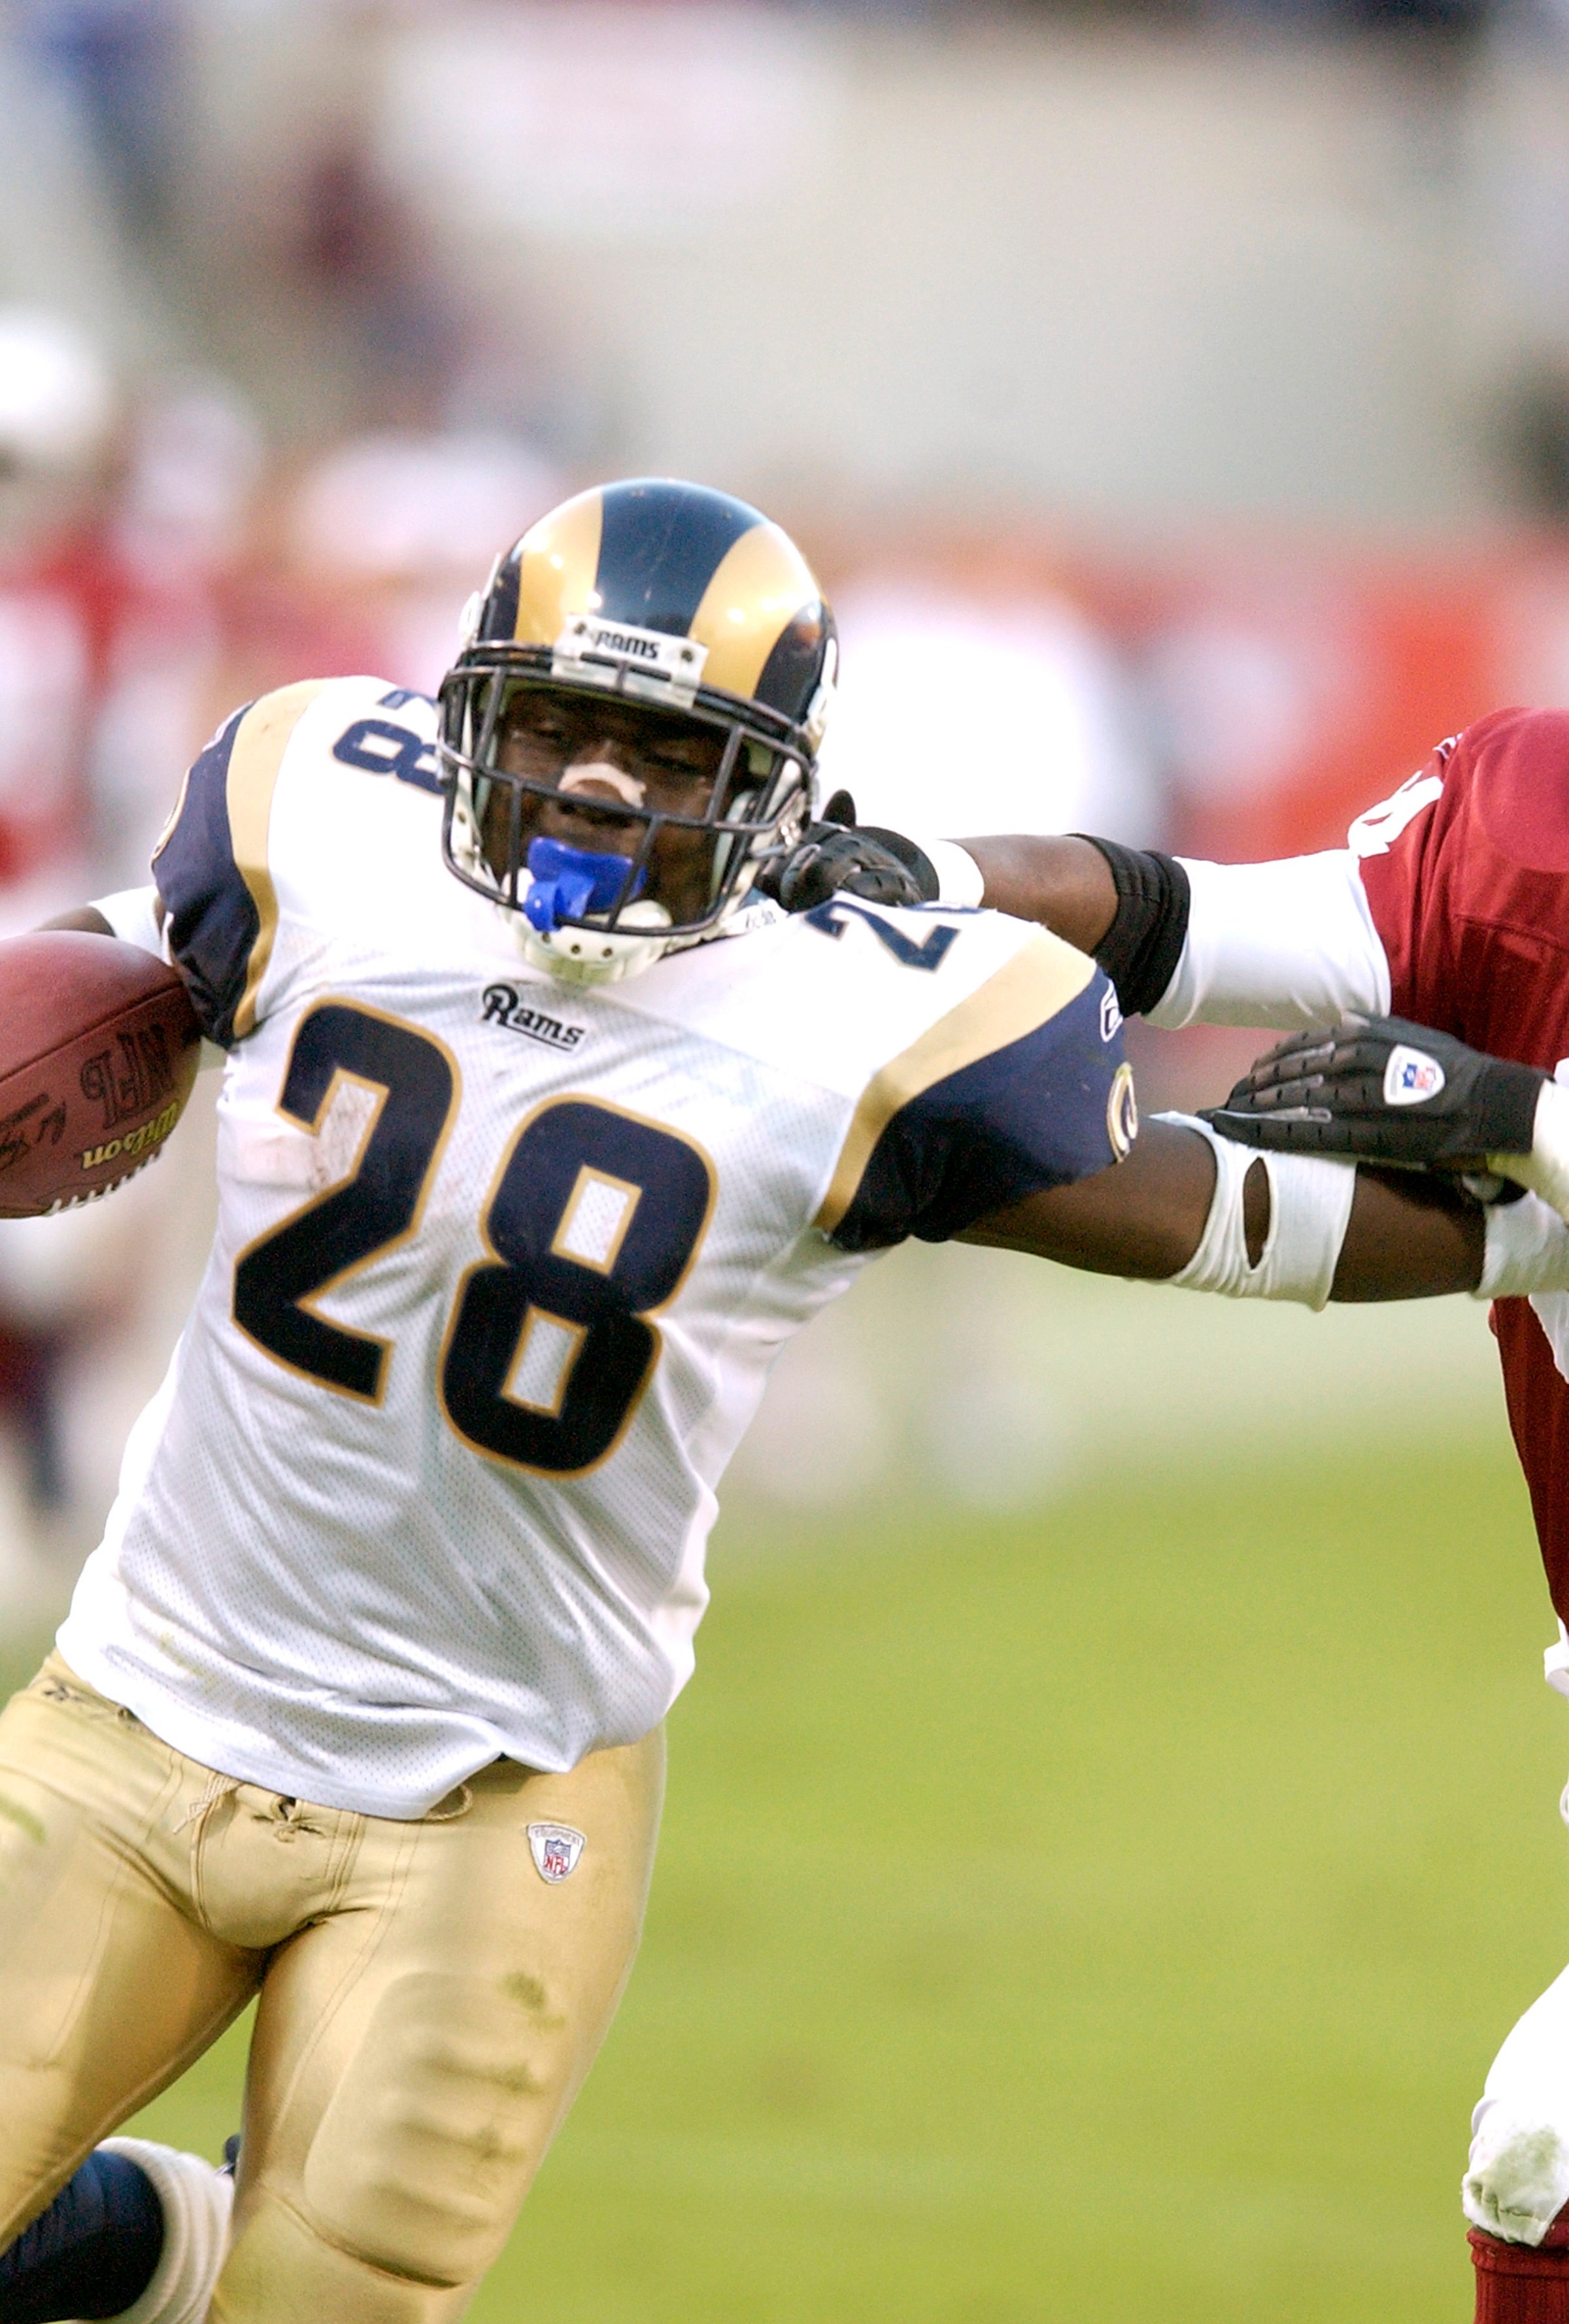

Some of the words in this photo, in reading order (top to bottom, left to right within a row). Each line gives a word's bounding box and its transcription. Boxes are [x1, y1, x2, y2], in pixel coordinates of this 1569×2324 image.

[596, 630, 661, 660] RAMS
[482, 983, 585, 1051] Rams
[81, 1100, 179, 1170] Wilson
[231, 996, 719, 1480] 28
[544, 1855, 568, 1874] NFL
